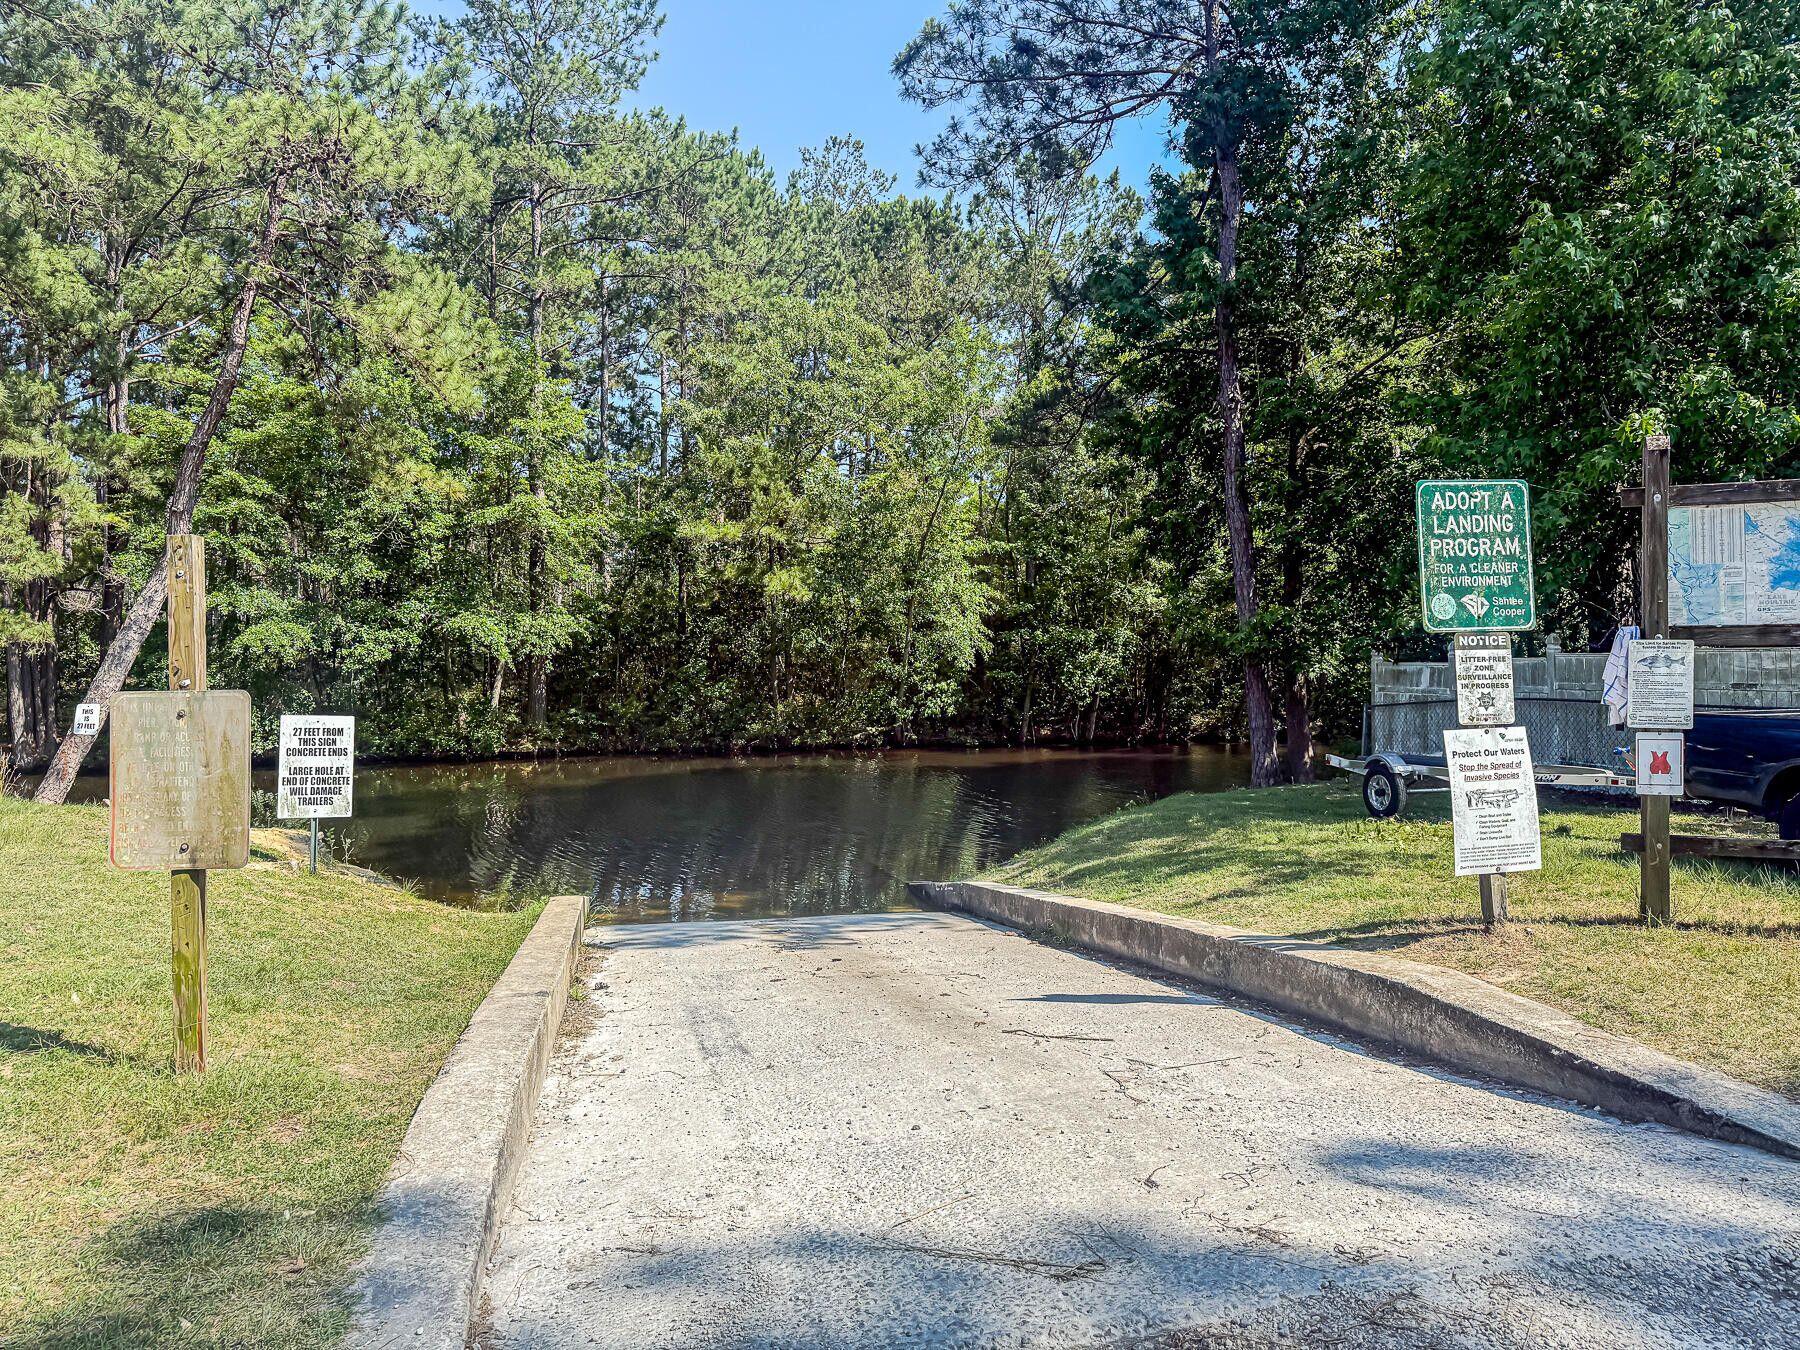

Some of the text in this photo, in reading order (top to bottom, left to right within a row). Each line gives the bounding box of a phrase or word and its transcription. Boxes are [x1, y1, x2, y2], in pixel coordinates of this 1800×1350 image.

[1431, 491, 1514, 510] ADOPT A
[1433, 514, 1514, 534] LANDING
[1430, 537, 1520, 557] PROGRAM
[1434, 562, 1518, 574] FOR A CLEANER
[1441, 575, 1513, 587] ENVIRONMENT
[1492, 597, 1523, 605] Santee
[1492, 607, 1525, 617] Cooper
[1459, 635, 1506, 646] NOTICE
[1461, 655, 1506, 663] LITTER-FREE
[293, 728, 344, 736] 27 FEET FROM
[298, 737, 337, 746] THIS SIGN
[286, 748, 348, 756] CONCRETE ENDS
[1452, 748, 1525, 759] Protect Our Waters
[289, 767, 344, 775] LARGE HOLE AT
[1459, 761, 1522, 772] Stop the Spread of
[1464, 772, 1520, 781] Invasive Species
[282, 777, 350, 786] END OF CONCRETE
[289, 787, 342, 796] WILL DAMAGE
[298, 797, 334, 806] TRAILERS
